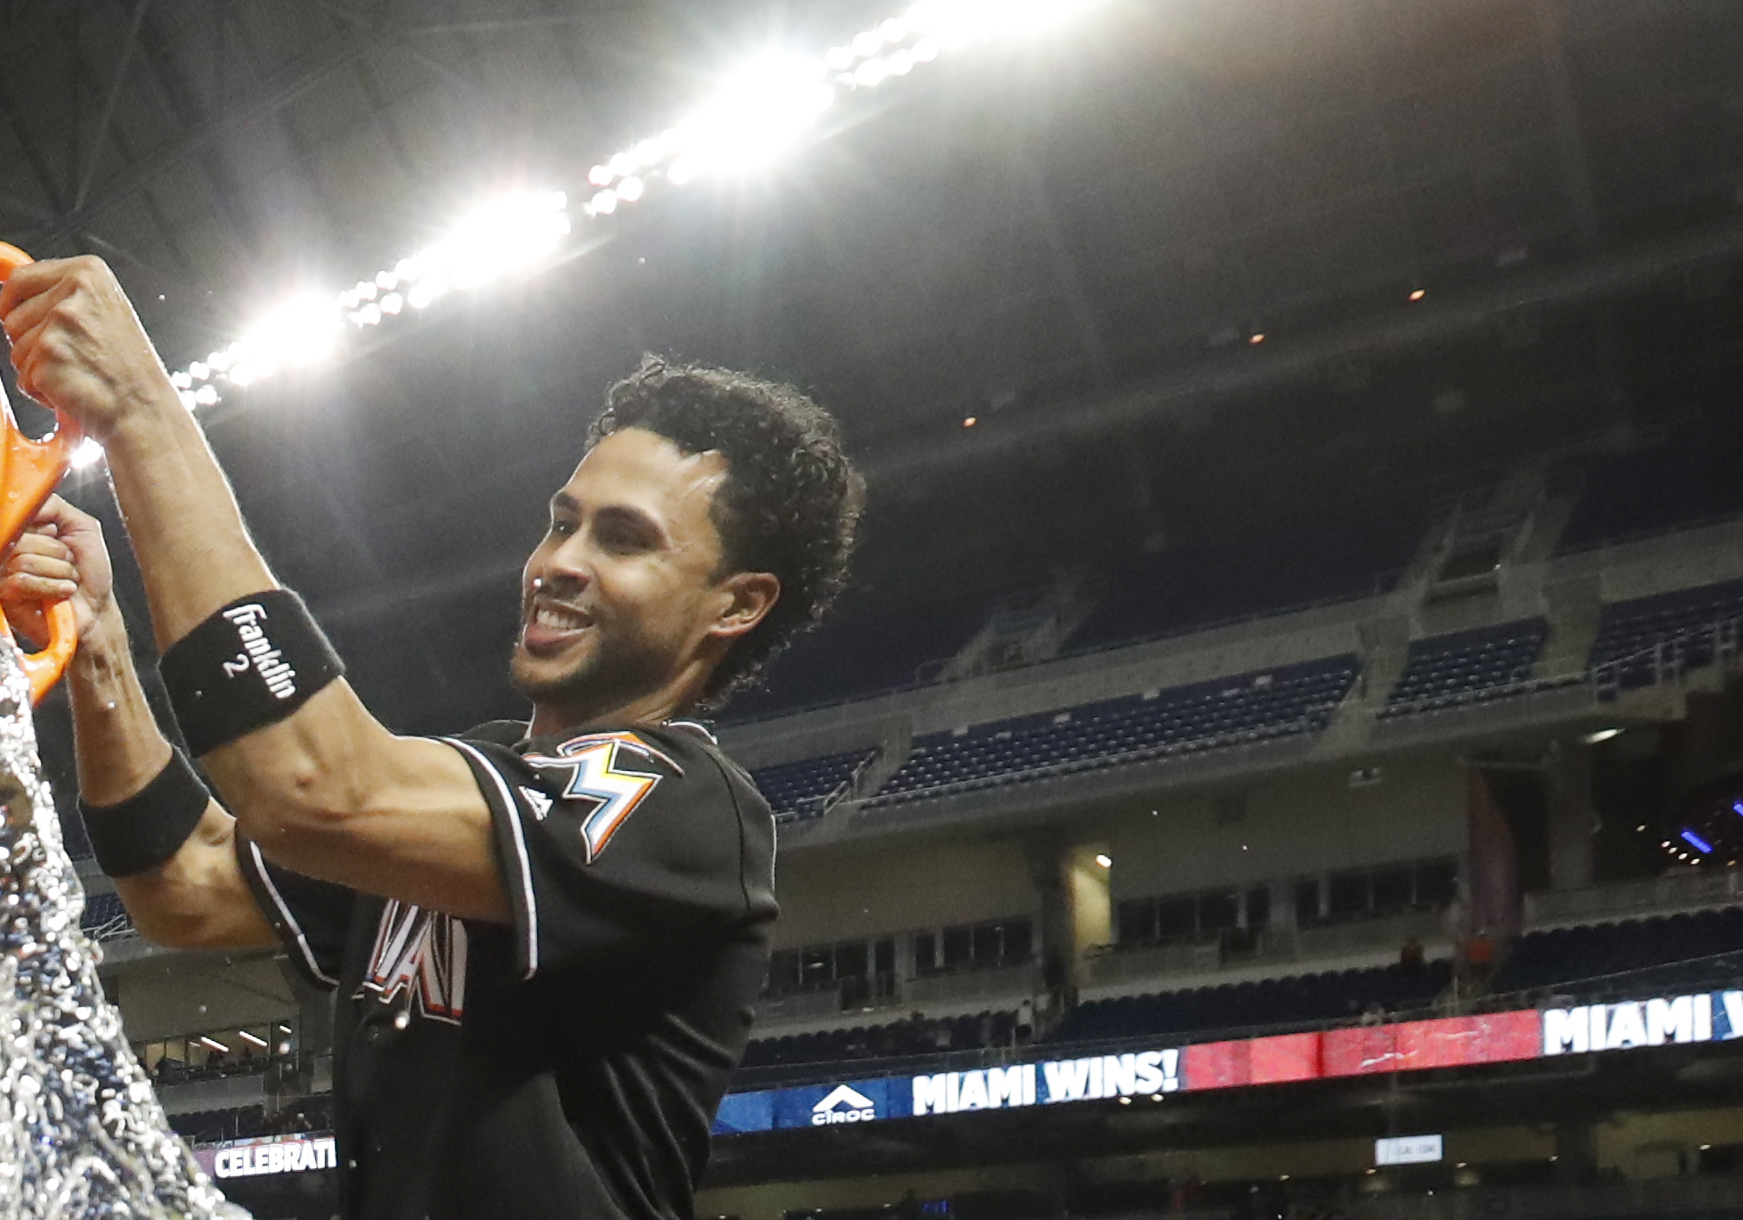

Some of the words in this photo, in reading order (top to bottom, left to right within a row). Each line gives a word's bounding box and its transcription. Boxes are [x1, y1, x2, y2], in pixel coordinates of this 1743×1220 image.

[222, 603, 296, 699] Franklin
[222, 653, 250, 678] 2
[1543, 993, 1712, 1056] MIAMI
[912, 1063, 1036, 1116] MIAMI
[1041, 1048, 1179, 1104] WINS!
